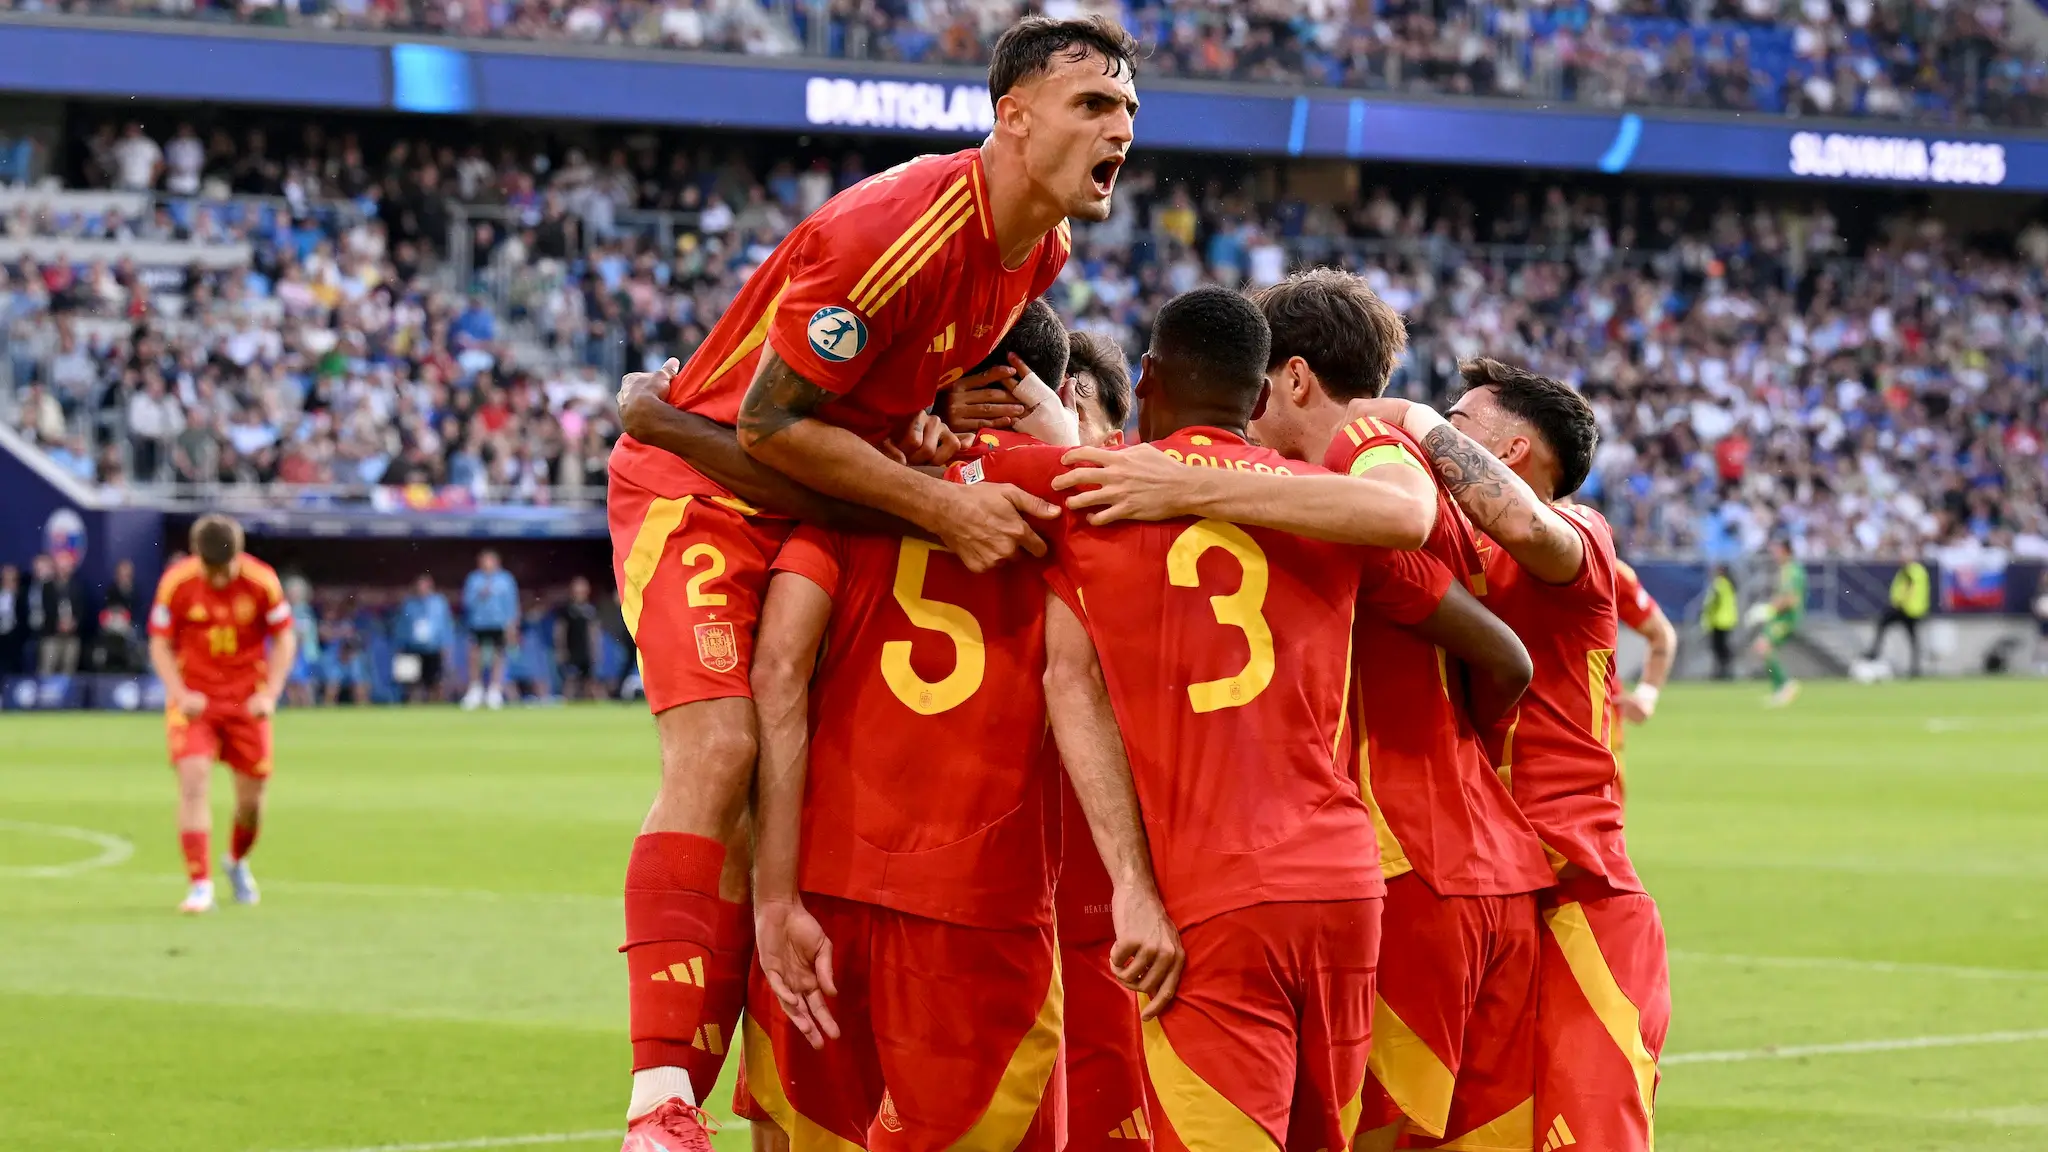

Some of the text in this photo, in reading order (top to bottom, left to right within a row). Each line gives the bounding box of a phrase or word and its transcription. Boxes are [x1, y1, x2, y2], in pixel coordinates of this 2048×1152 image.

[806, 77, 993, 132] BRATISLAV
[1789, 131, 1929, 181] SLOVAKIA
[682, 543, 727, 607] 2
[881, 535, 985, 715] 5
[1167, 519, 1275, 713] 3
